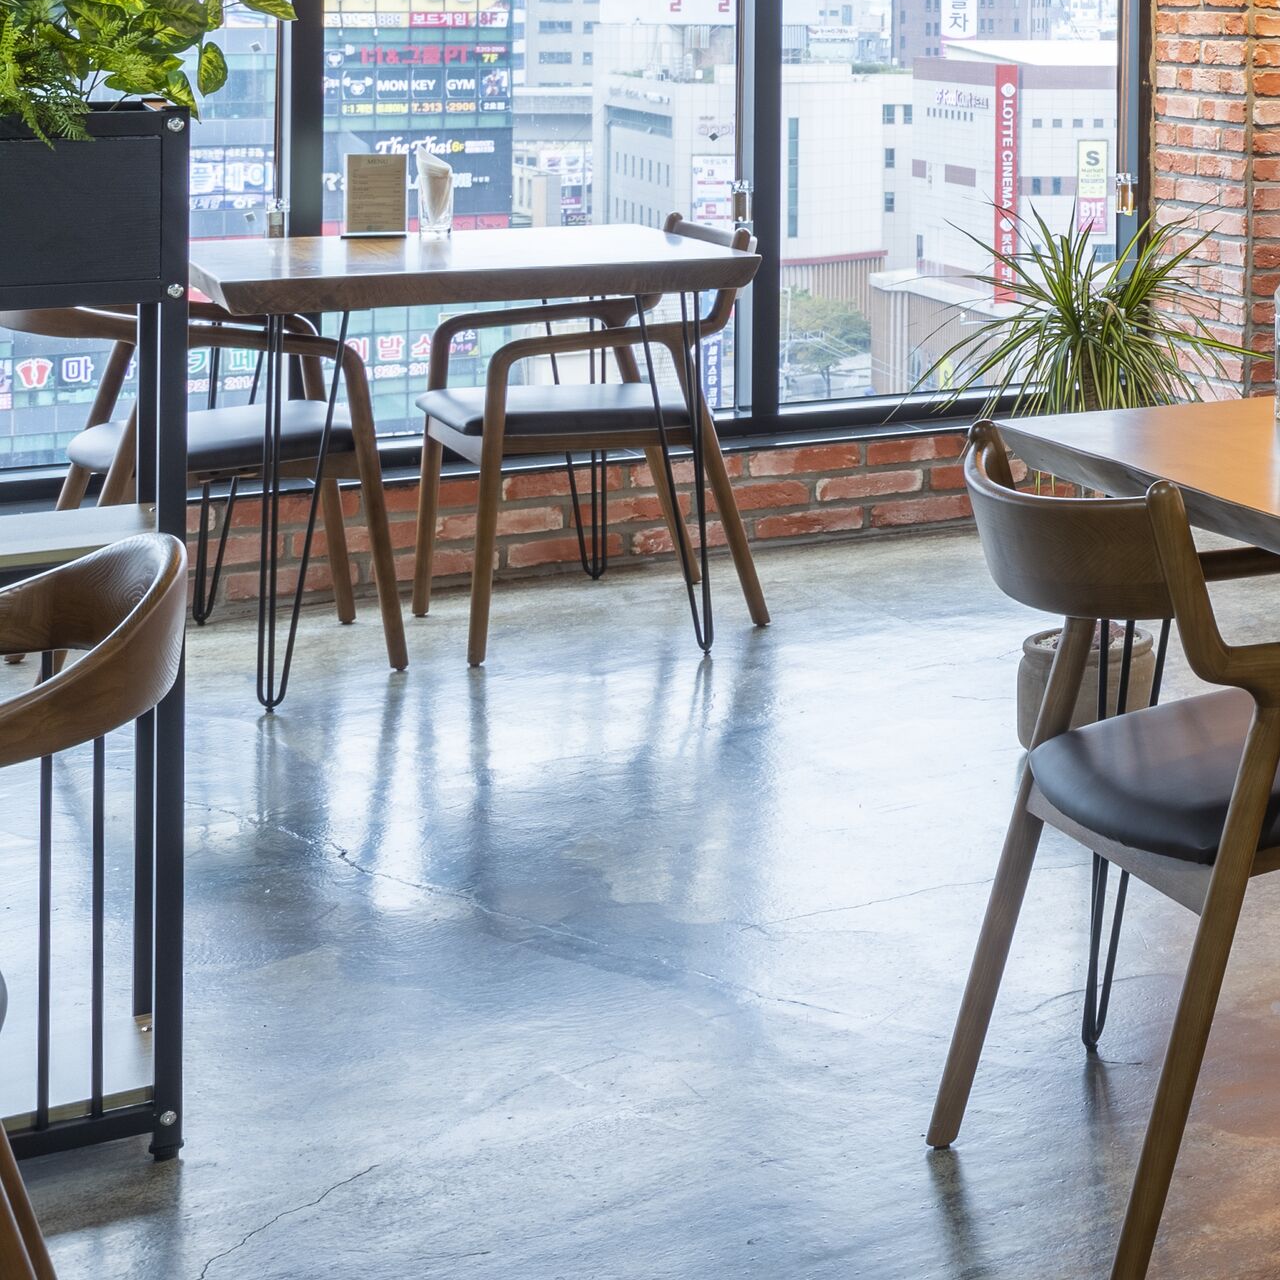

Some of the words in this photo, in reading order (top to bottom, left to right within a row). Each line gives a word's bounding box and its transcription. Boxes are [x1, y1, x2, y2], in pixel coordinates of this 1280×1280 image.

[411, 12, 468, 27] 보드게임
[482, 53, 499, 64] 7F
[446, 78, 476, 91] GYM
[1002, 99, 1014, 148] LOTTE
[375, 135, 410, 155] The
[1085, 150, 1100, 167] S
[1002, 149, 1014, 209] CINEMA
